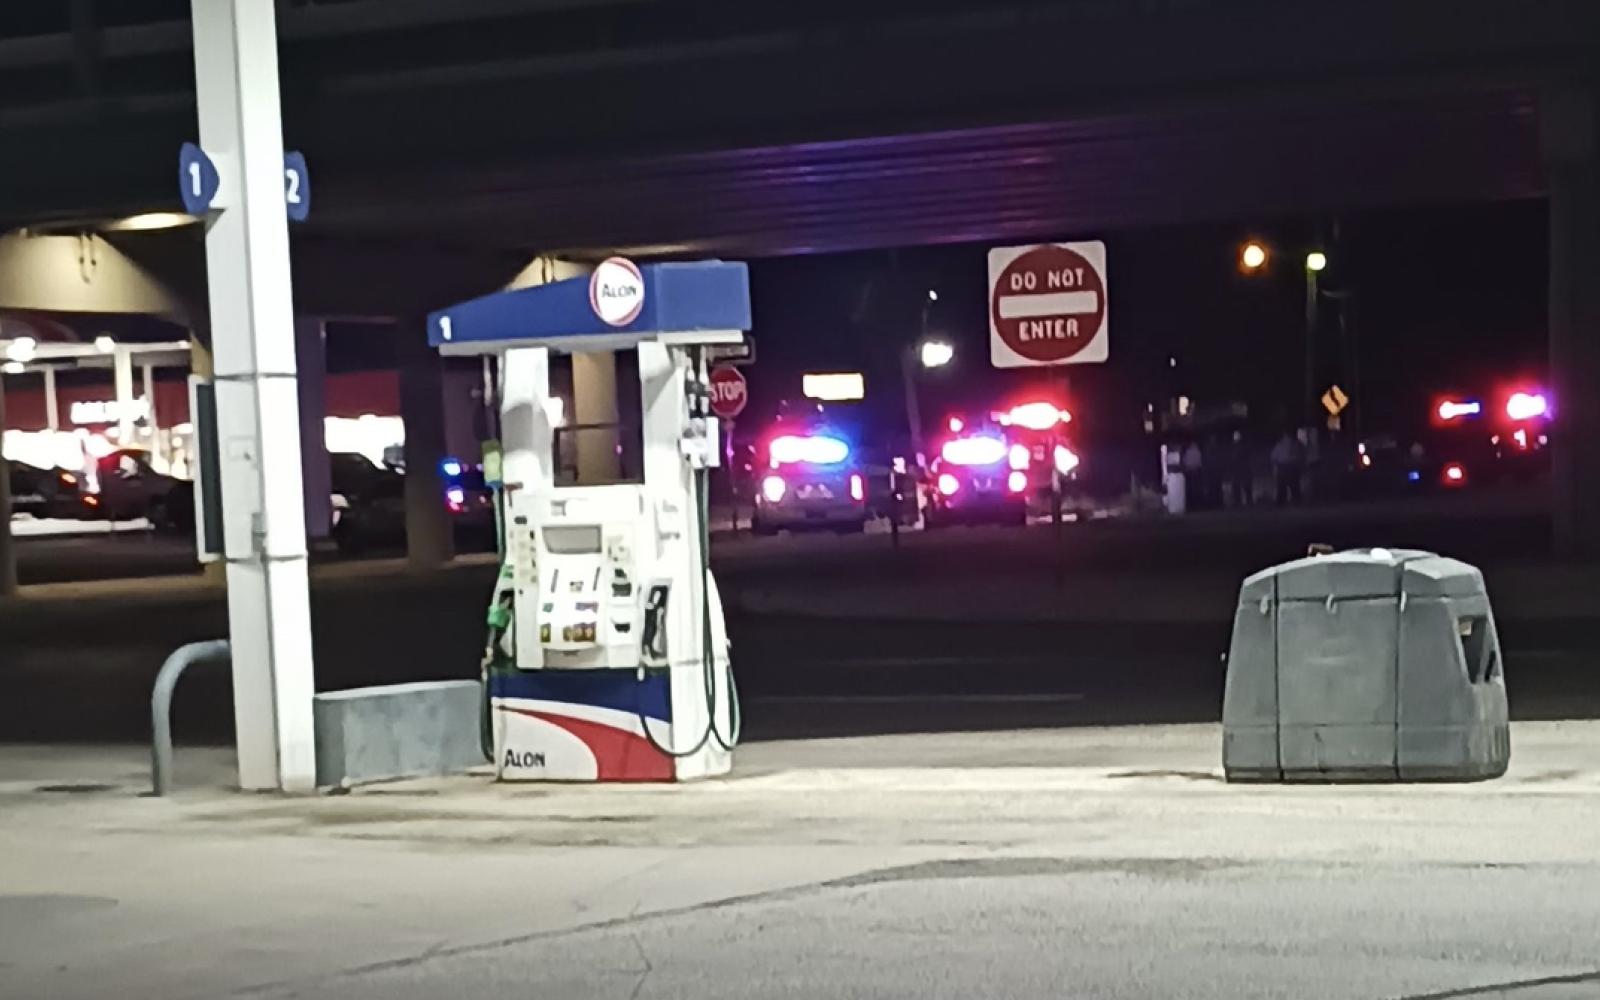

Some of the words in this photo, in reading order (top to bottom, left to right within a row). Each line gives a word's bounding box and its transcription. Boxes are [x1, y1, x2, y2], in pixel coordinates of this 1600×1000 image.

[189, 162, 201, 196] 1
[286, 169, 300, 203] 2
[1010, 272, 1037, 290] DO
[1048, 268, 1083, 288] NOT
[440, 316, 451, 340] 1
[1019, 318, 1078, 341] ENTER
[711, 381, 744, 402] STOP
[505, 749, 545, 767] ALON
